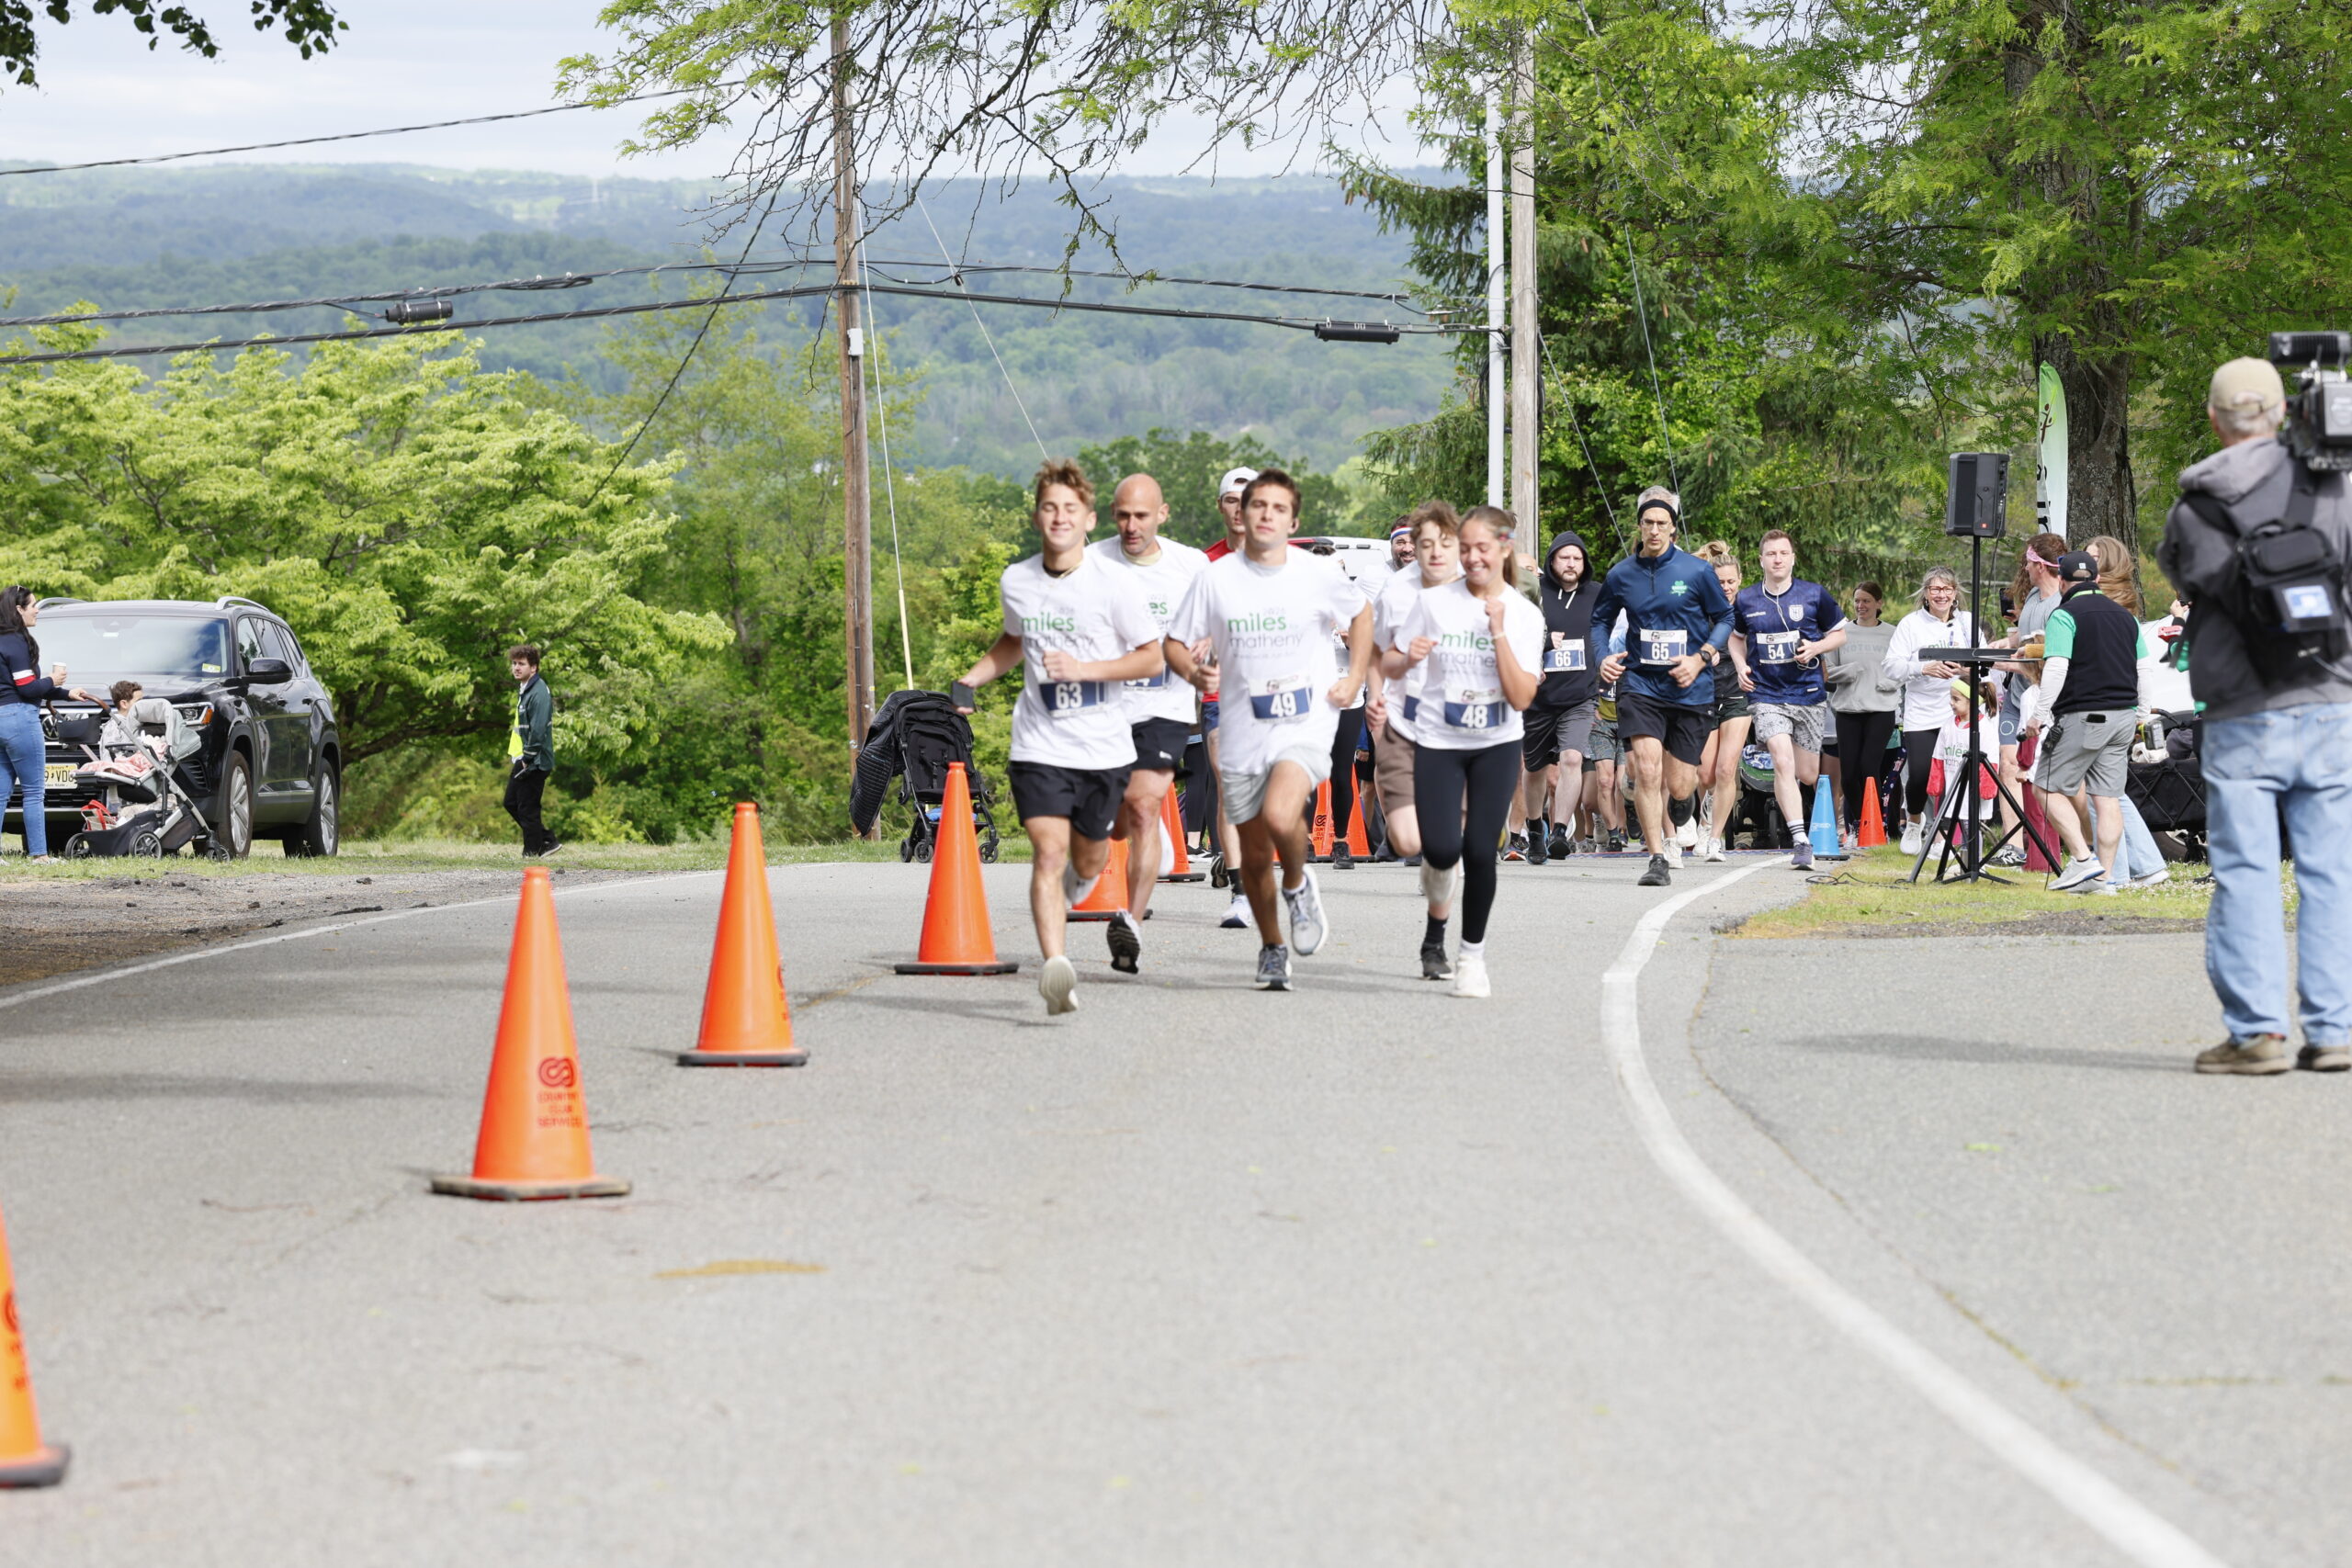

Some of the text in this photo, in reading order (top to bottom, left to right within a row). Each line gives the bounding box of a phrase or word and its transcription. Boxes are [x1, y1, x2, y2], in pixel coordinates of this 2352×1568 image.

[1021, 611, 1075, 632] miles
[1227, 612, 1287, 632] miles
[1439, 651, 1496, 669] mathe
[1555, 650, 1572, 668] 66
[1651, 642, 1669, 661] 65
[1767, 643, 1786, 660] 54
[1055, 682, 1083, 710] 63
[1270, 692, 1297, 717] 49
[1460, 704, 1488, 728] 48
